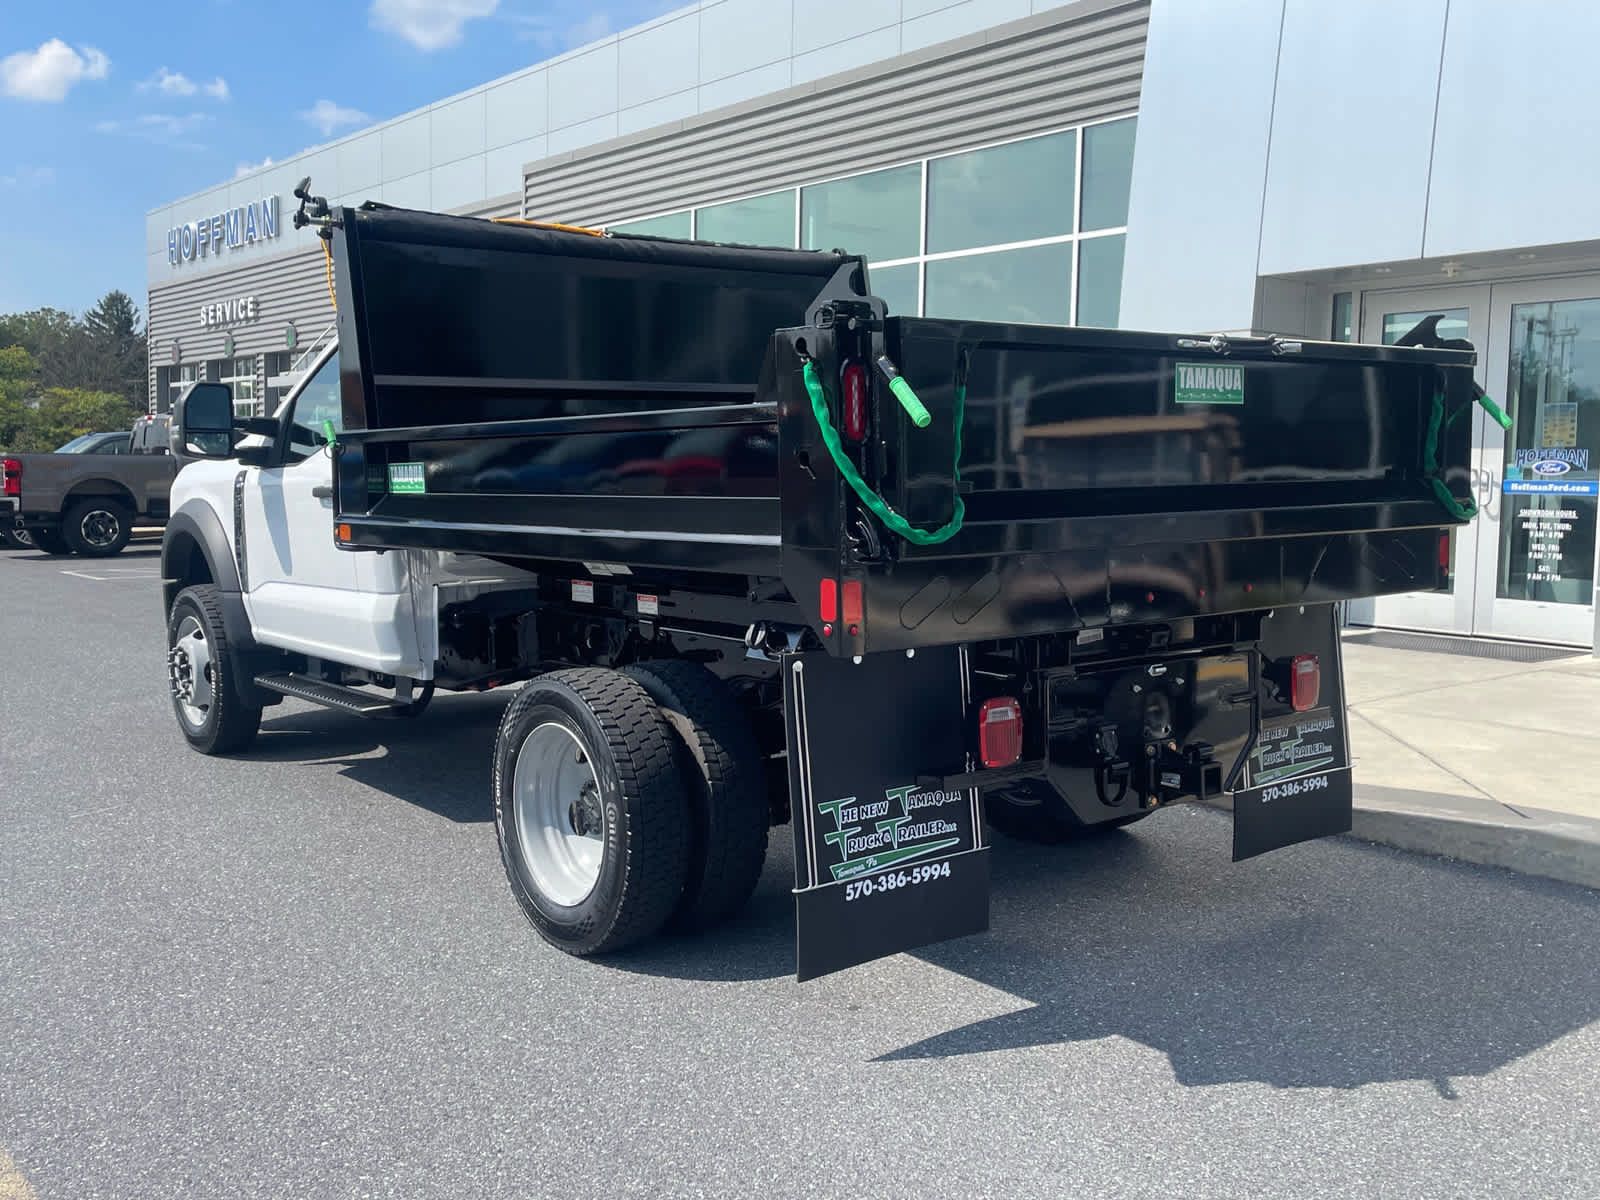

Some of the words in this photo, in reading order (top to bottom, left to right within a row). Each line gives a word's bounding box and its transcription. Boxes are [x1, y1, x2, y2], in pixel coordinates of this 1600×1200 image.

[168, 195, 279, 264] HOFFMAN
[200, 297, 256, 326] SERVICE
[1179, 367, 1242, 392] TAMAQUA
[1515, 449, 1589, 472] HOFFMAN
[1511, 483, 1590, 492] HoffmanFord.com
[1262, 776, 1329, 803] 570-386-5994
[818, 797, 858, 831] THE
[859, 801, 889, 820] NEW
[885, 785, 962, 816] TAMAQUA
[824, 827, 884, 862] TRUCK
[846, 862, 951, 902] 570-386-5994
